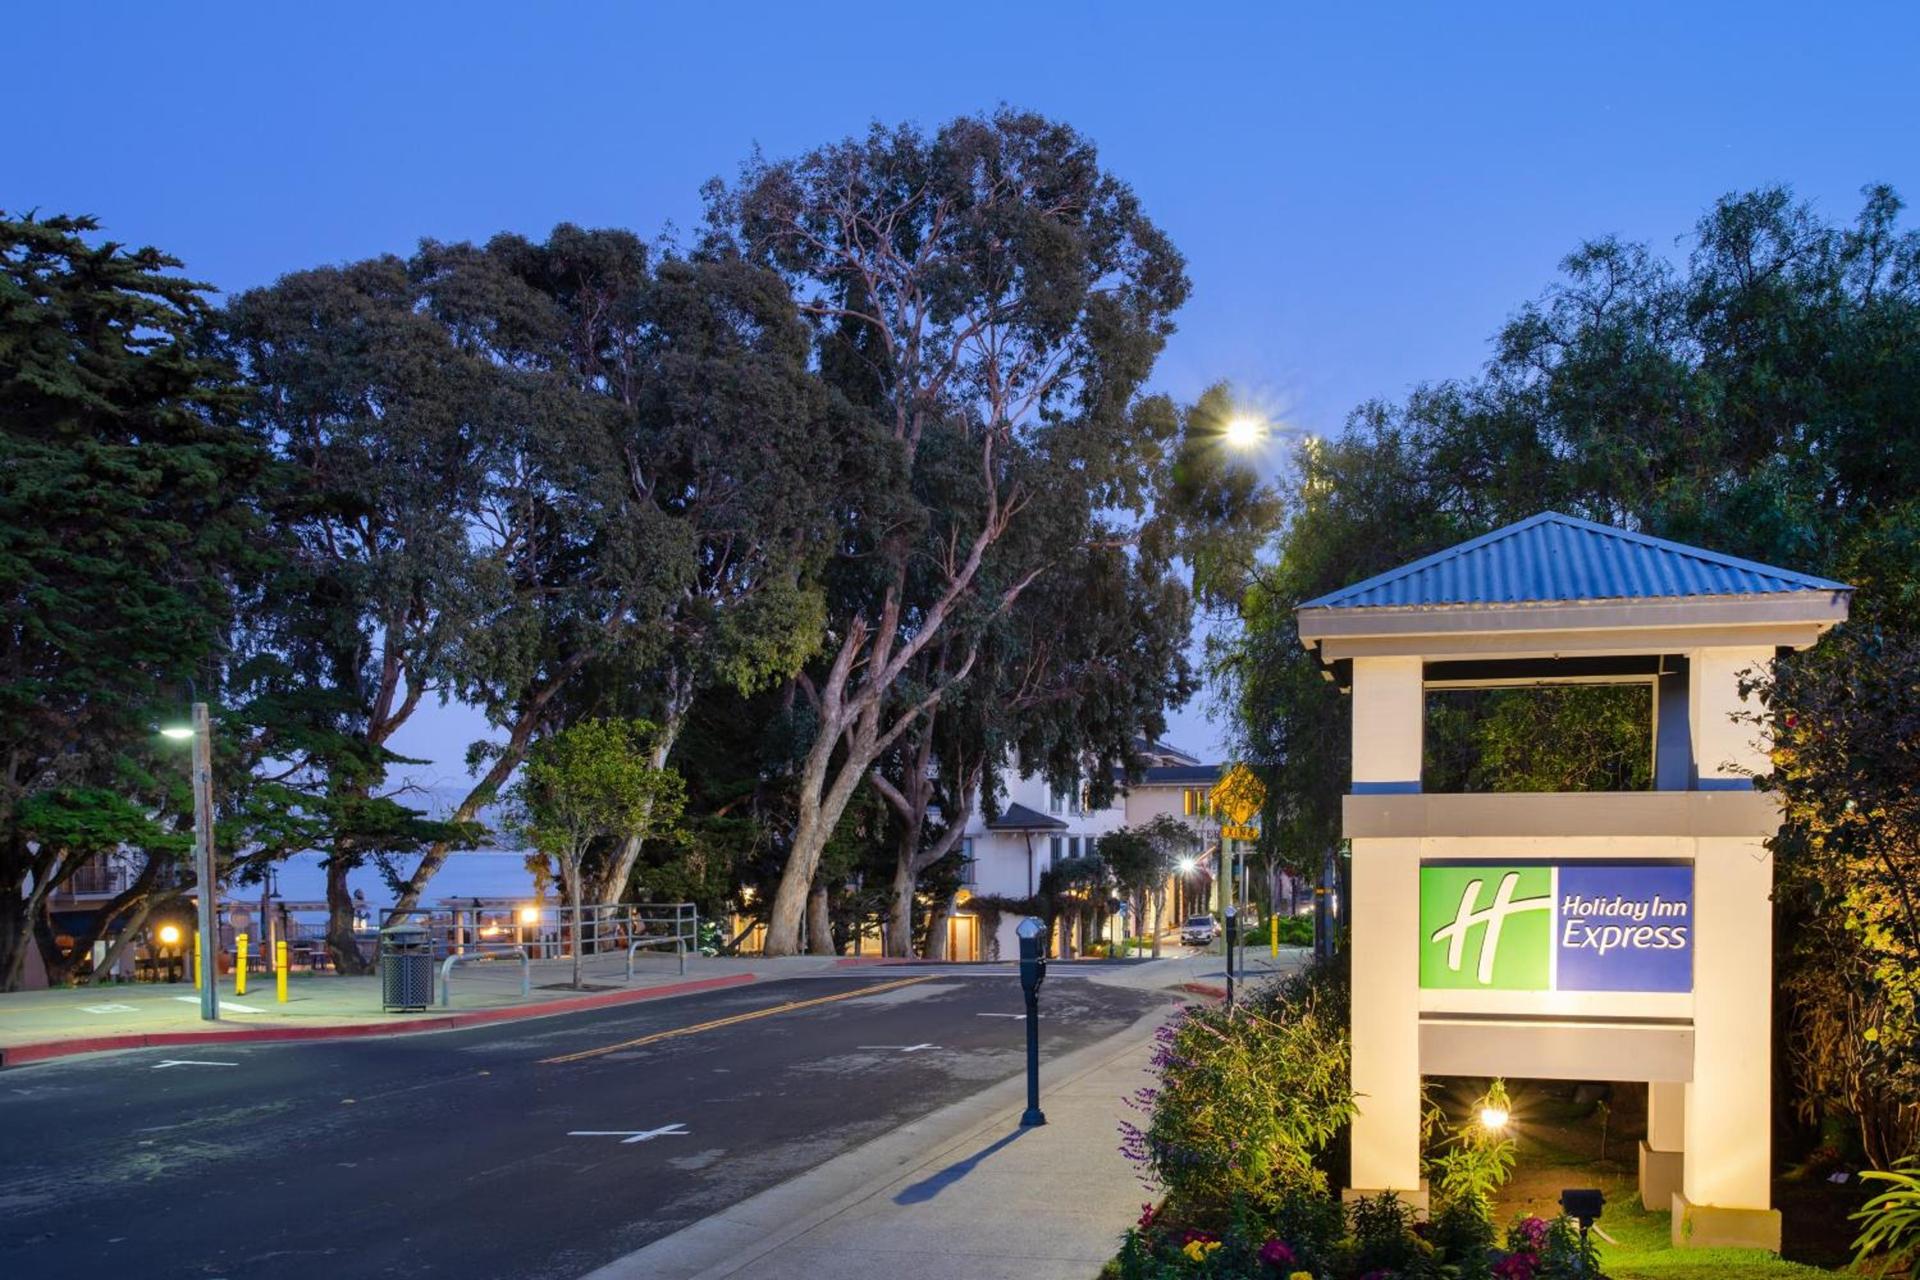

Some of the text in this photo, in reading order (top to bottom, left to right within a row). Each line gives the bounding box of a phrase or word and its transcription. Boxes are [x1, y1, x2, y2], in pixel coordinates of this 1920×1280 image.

[1228, 827, 1255, 837] XING
[1561, 895, 1688, 921] Holiday Inn
[1562, 919, 1688, 956] Express
